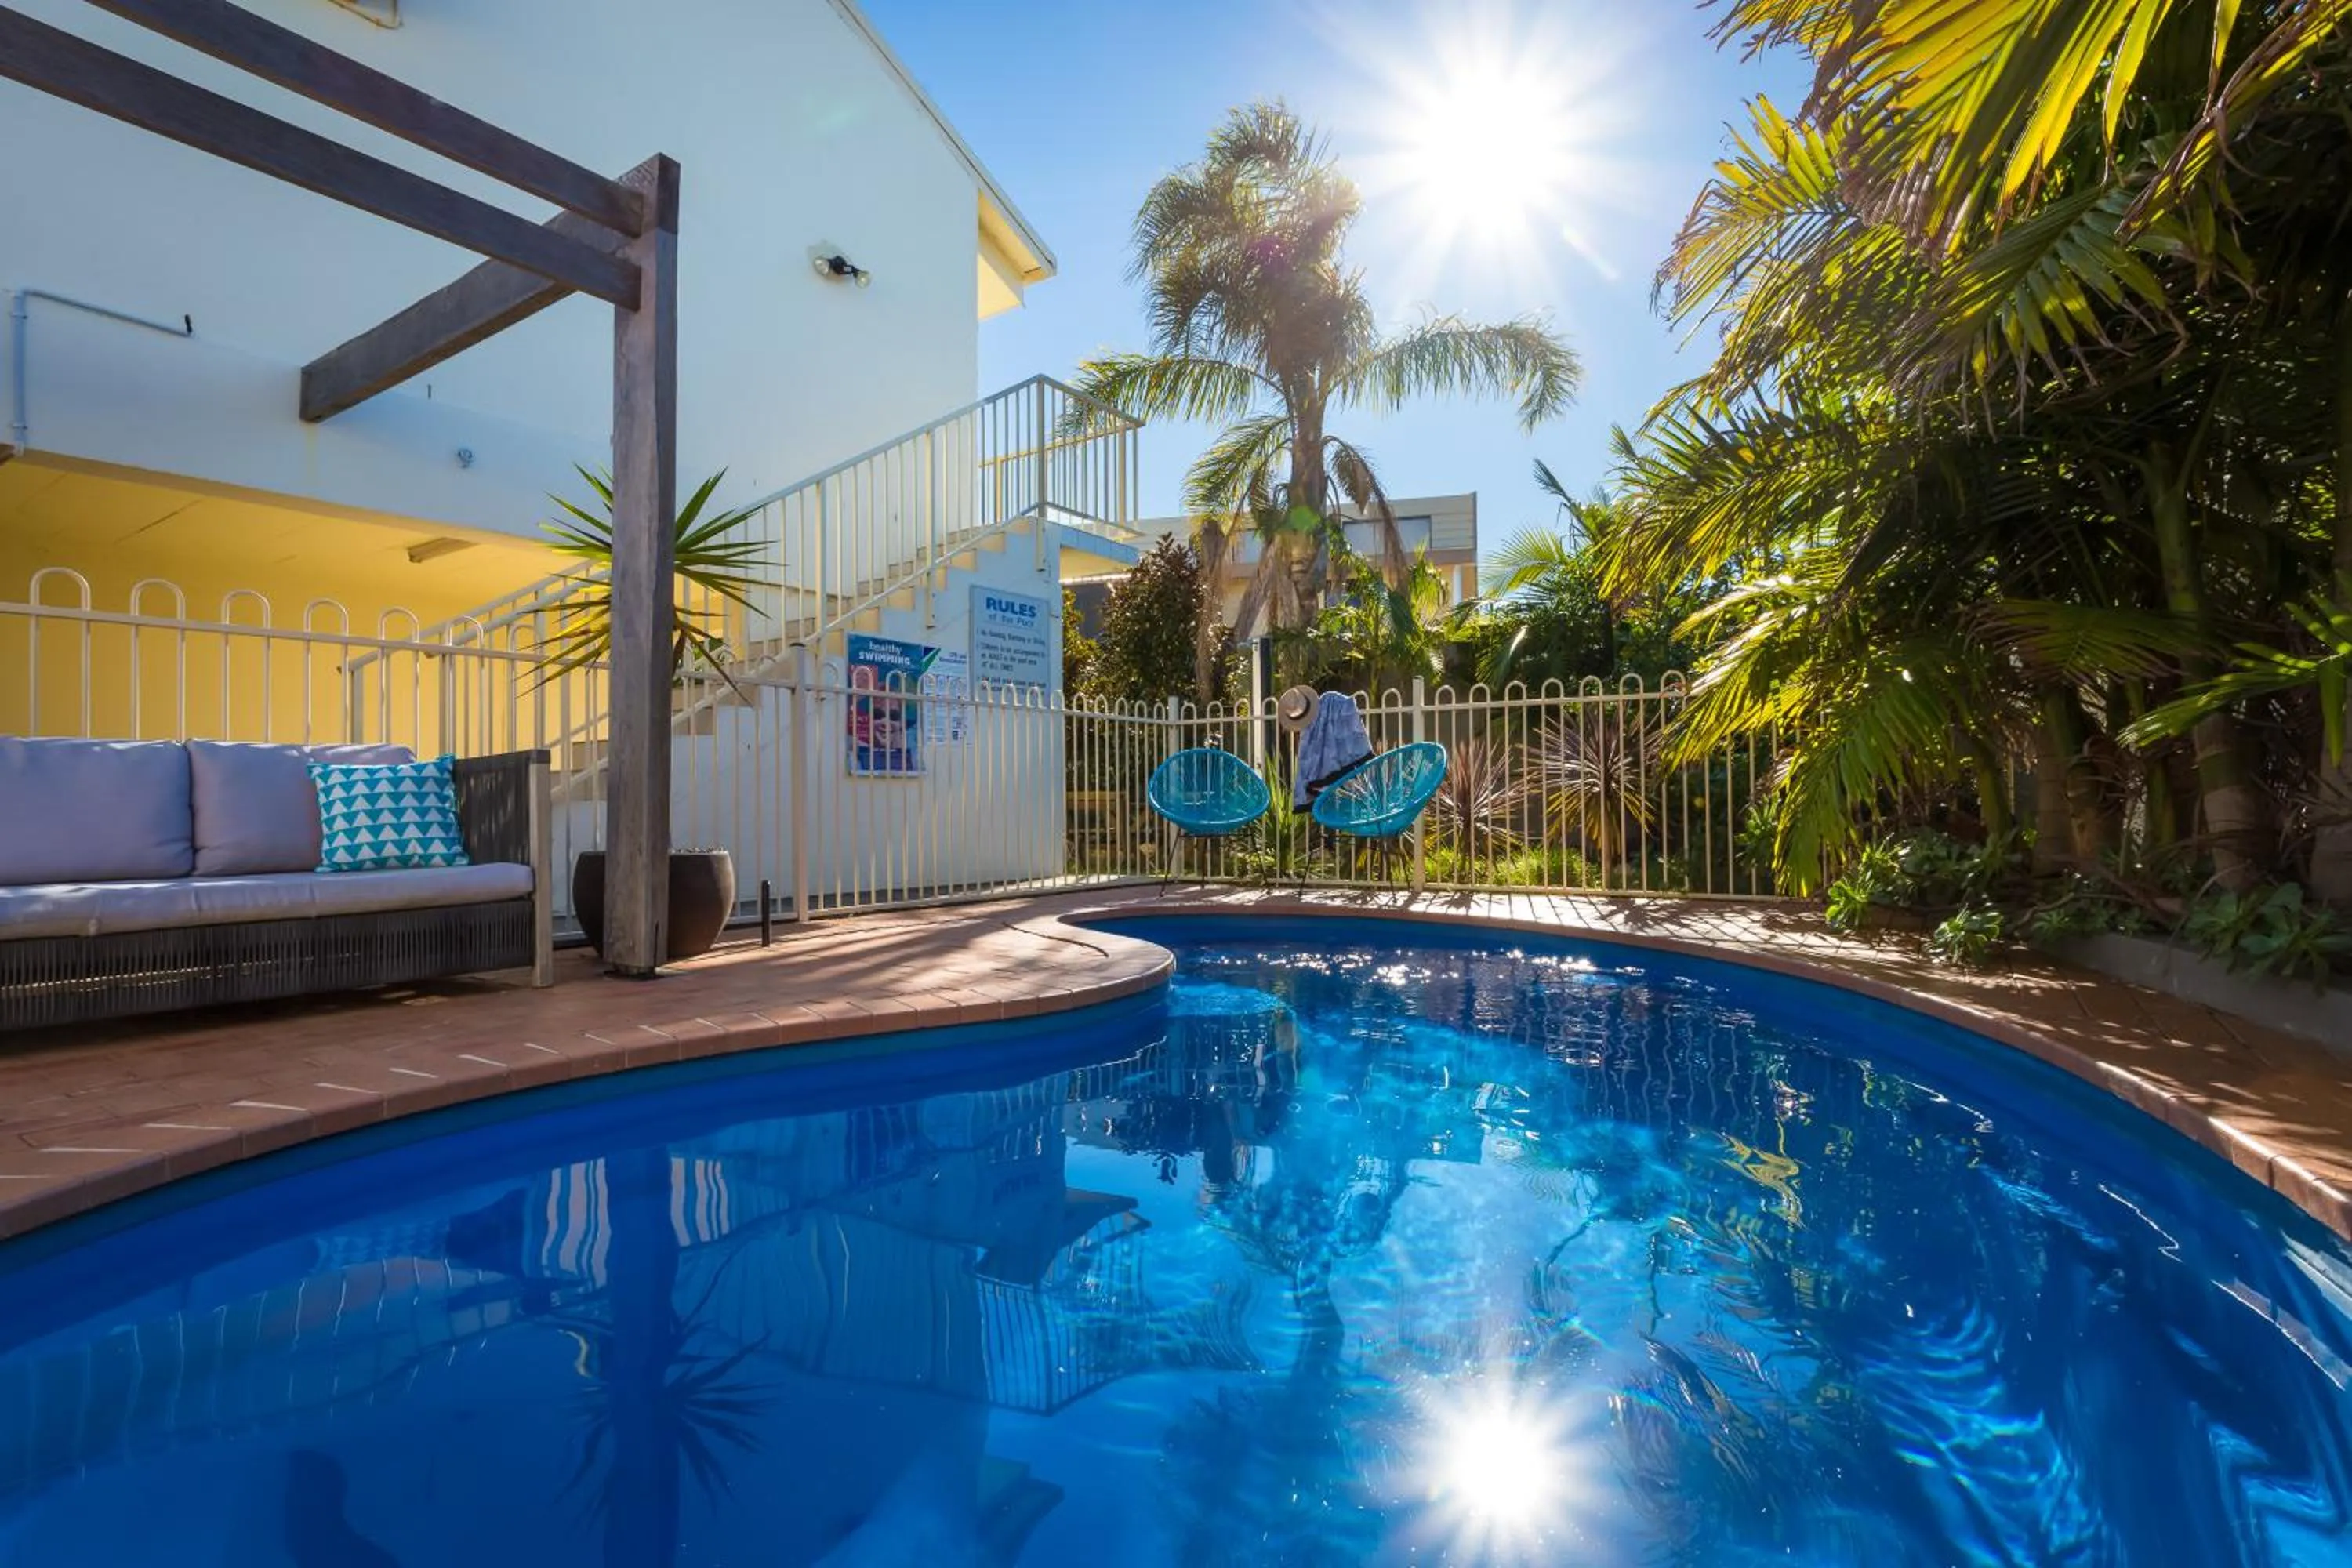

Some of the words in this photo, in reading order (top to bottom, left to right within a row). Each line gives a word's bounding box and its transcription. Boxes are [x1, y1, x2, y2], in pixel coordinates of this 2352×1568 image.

[986, 597, 1036, 618] RULES
[869, 641, 902, 655] healthy
[858, 650, 910, 666] SWIMMING
